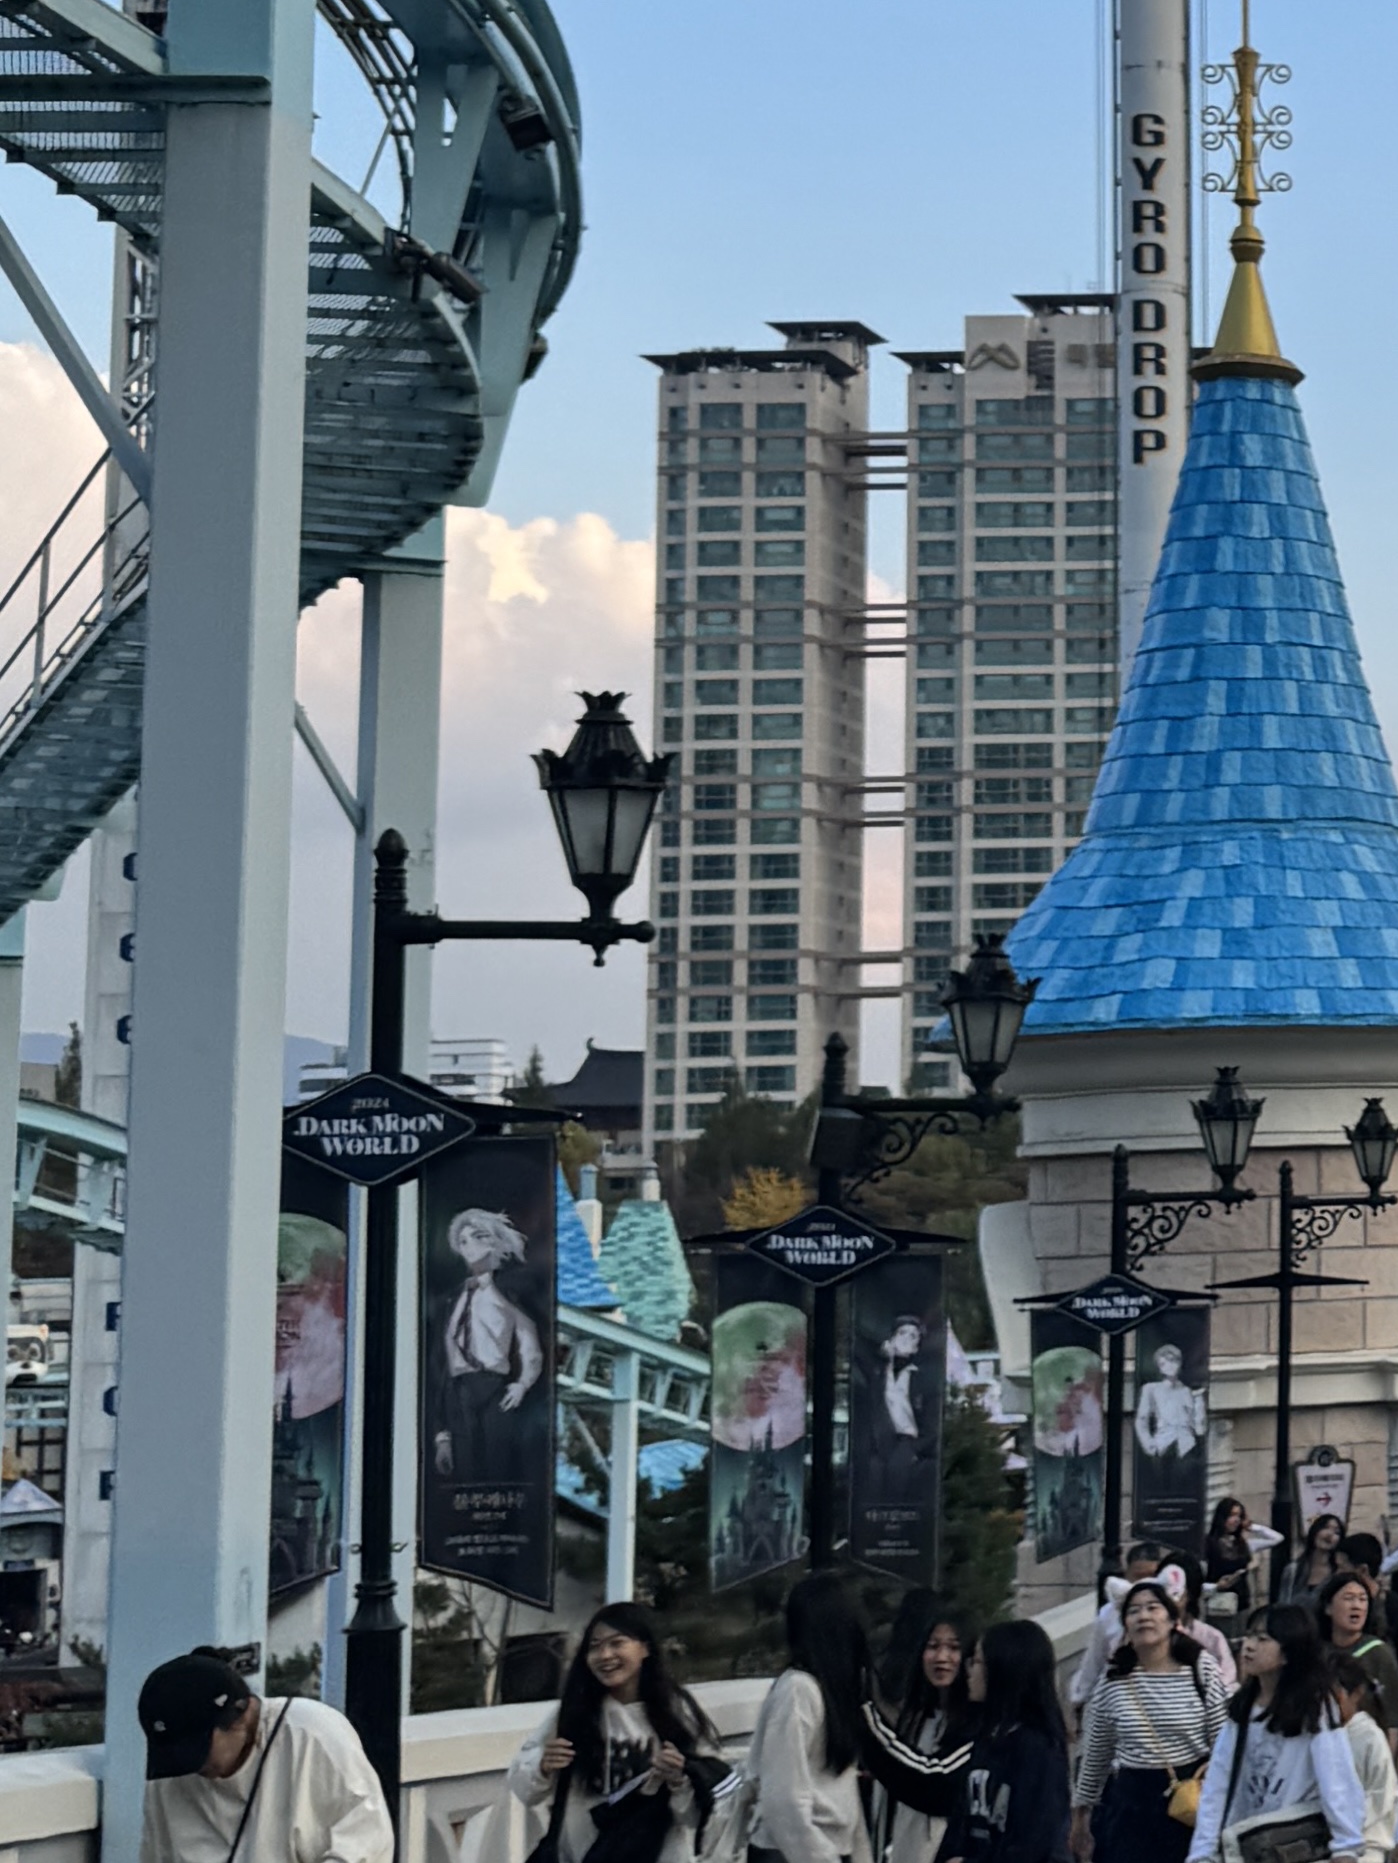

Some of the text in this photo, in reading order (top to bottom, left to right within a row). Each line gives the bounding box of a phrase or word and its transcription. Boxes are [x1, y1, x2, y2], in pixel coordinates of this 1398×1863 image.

[1132, 113, 1167, 464] GYRO DROP
[293, 1113, 445, 1136] DARK MOON
[320, 1134, 420, 1156] WORLD
[785, 1250, 856, 1265] WORLD
